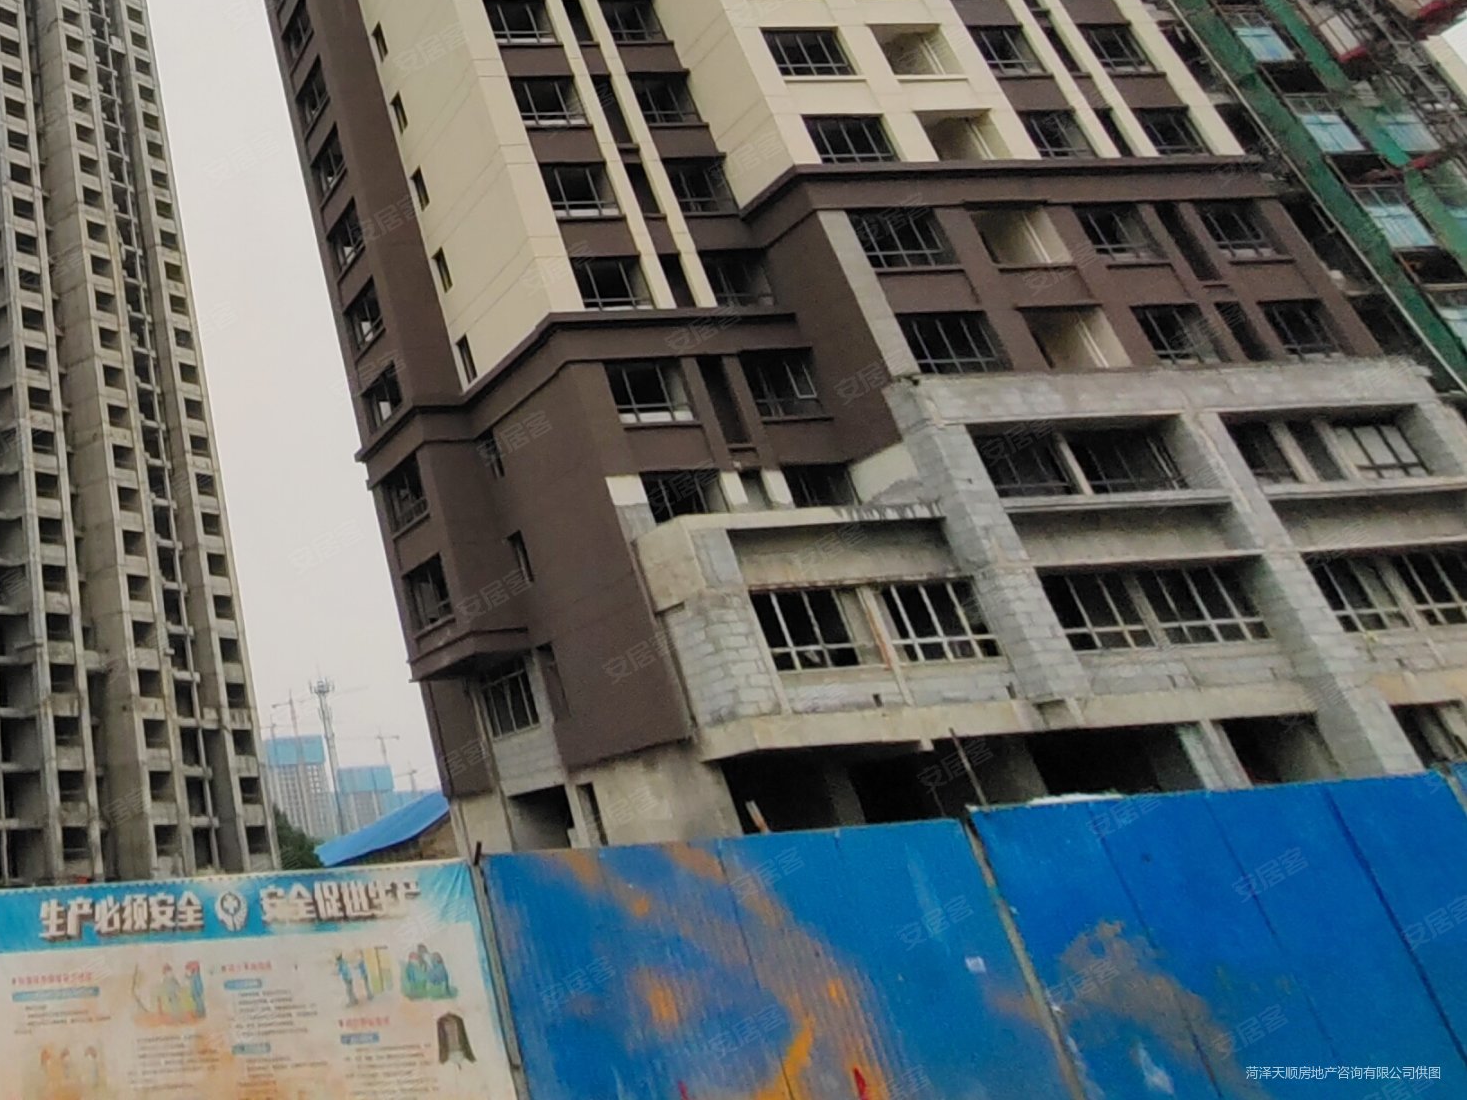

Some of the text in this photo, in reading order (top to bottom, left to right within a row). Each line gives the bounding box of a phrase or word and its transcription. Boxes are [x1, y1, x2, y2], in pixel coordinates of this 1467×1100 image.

[38, 891, 204, 940] 生产必须安全
